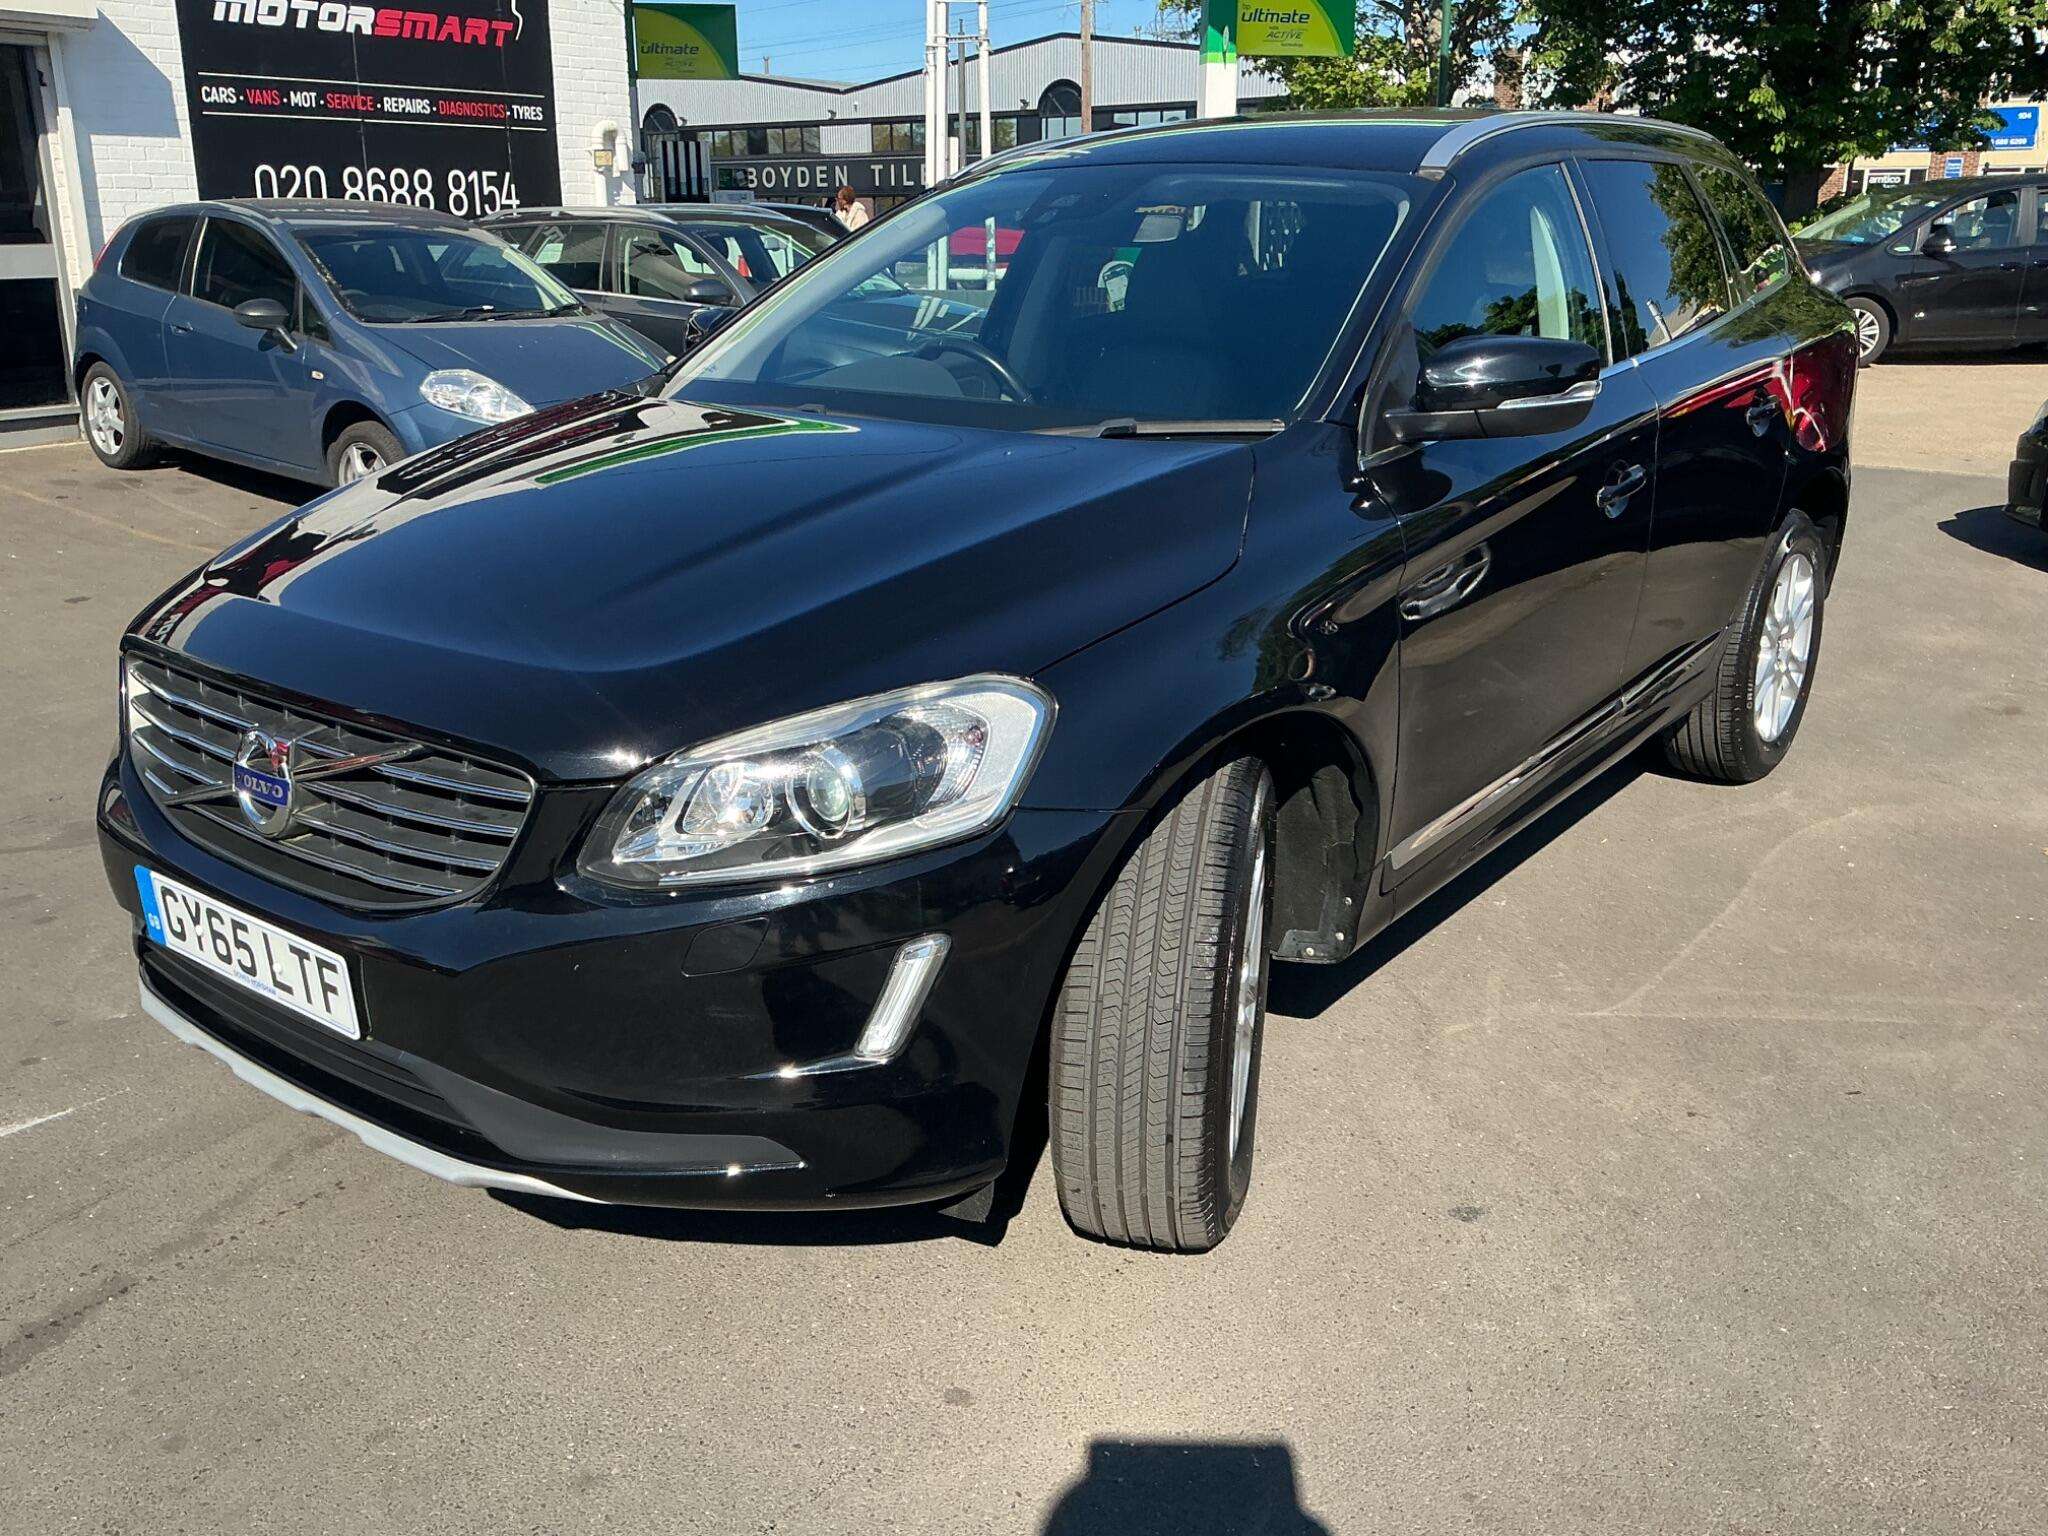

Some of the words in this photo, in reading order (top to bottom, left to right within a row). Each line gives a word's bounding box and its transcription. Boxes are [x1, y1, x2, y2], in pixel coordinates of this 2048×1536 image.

[213, 0, 514, 46] MOTORSMART
[1241, 8, 1310, 24] ultimate
[641, 43, 699, 55] ultimate
[201, 86, 236, 104] CARS
[246, 88, 281, 106] VANS
[290, 91, 317, 108] MOT
[326, 93, 374, 111] SERVICE
[383, 97, 431, 114] REPAIRS
[438, 100, 506, 118] DIAGNOSTICS
[512, 105, 543, 120] TYRES
[254, 165, 327, 199] 020
[343, 166, 435, 210] 8688
[447, 169, 520, 217] 8154
[748, 165, 848, 188] BOYDEN
[160, 885, 258, 978] GY65
[262, 931, 339, 1015] LTF
